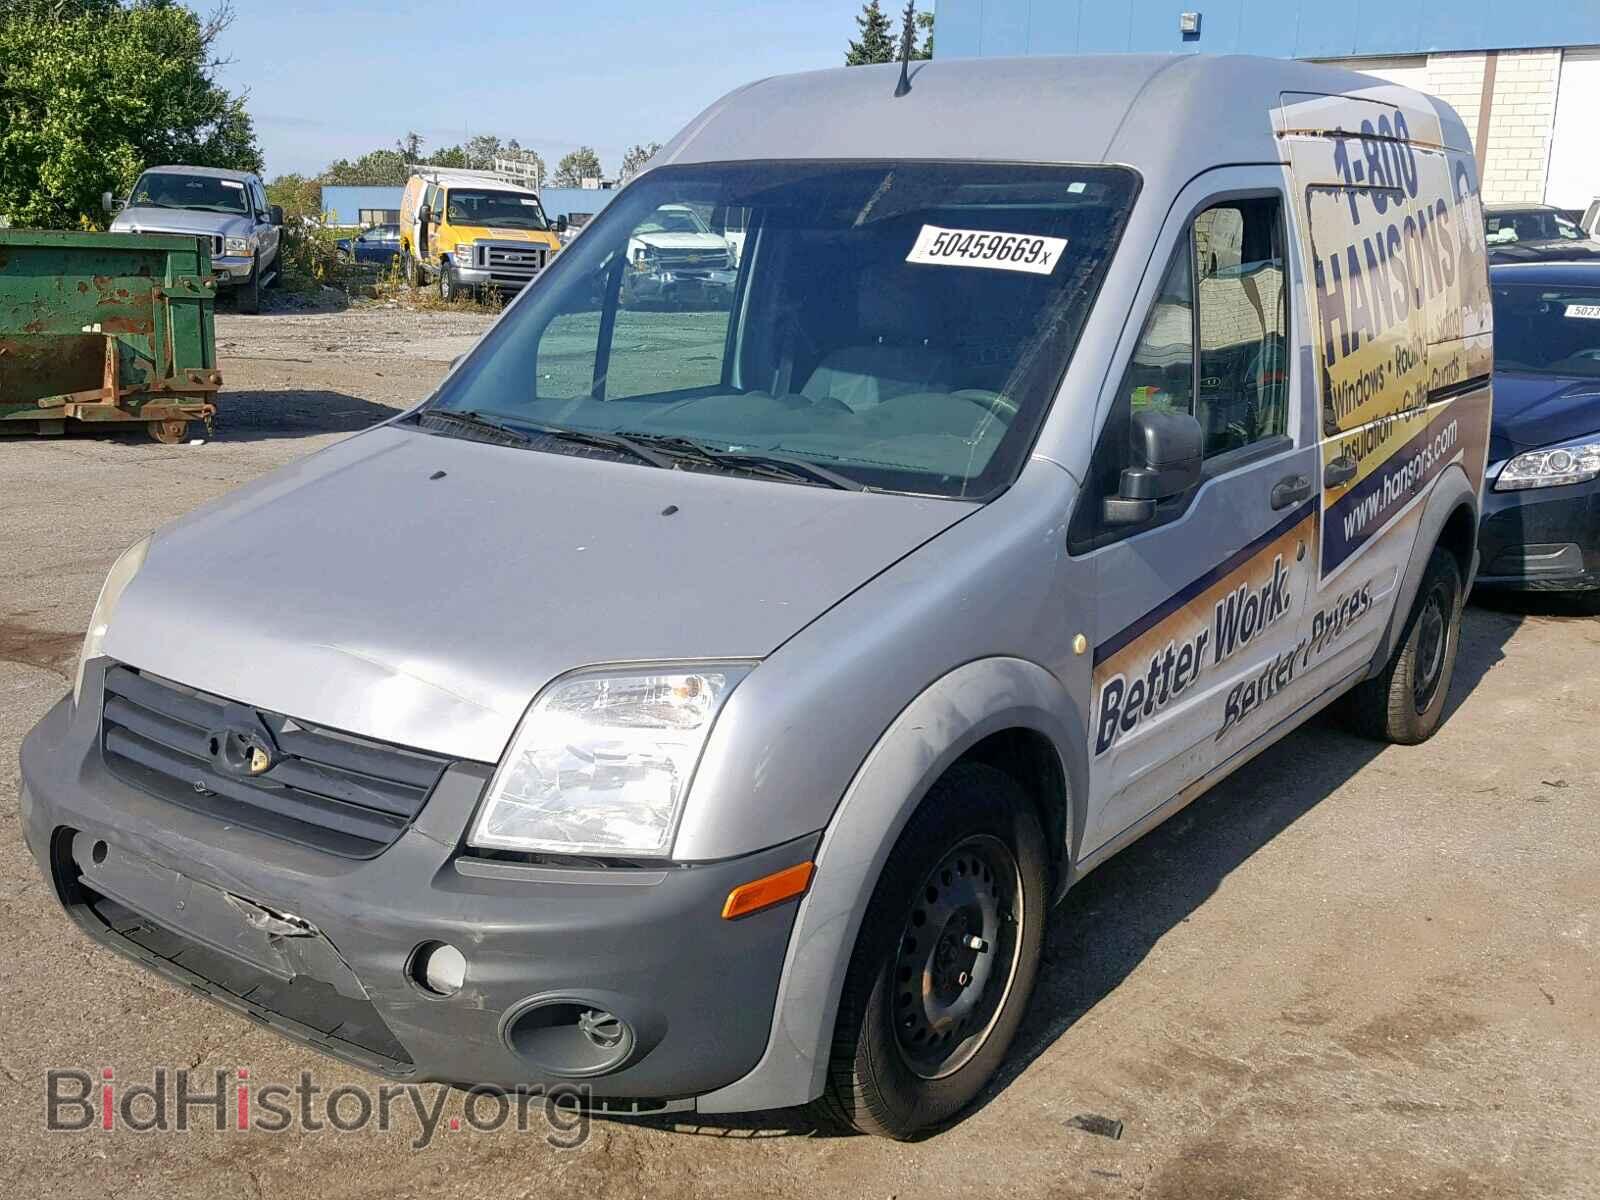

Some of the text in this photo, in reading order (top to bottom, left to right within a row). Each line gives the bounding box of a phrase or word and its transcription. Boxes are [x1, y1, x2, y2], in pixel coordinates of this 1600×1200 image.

[1333, 110, 1417, 225] 1-800
[1313, 198, 1454, 366] HANSONS
[1332, 365, 1385, 422] Windows
[1338, 413, 1393, 466] Insulation
[1343, 417, 1458, 542] www.hansons.com
[1095, 555, 1291, 757] Better Work.
